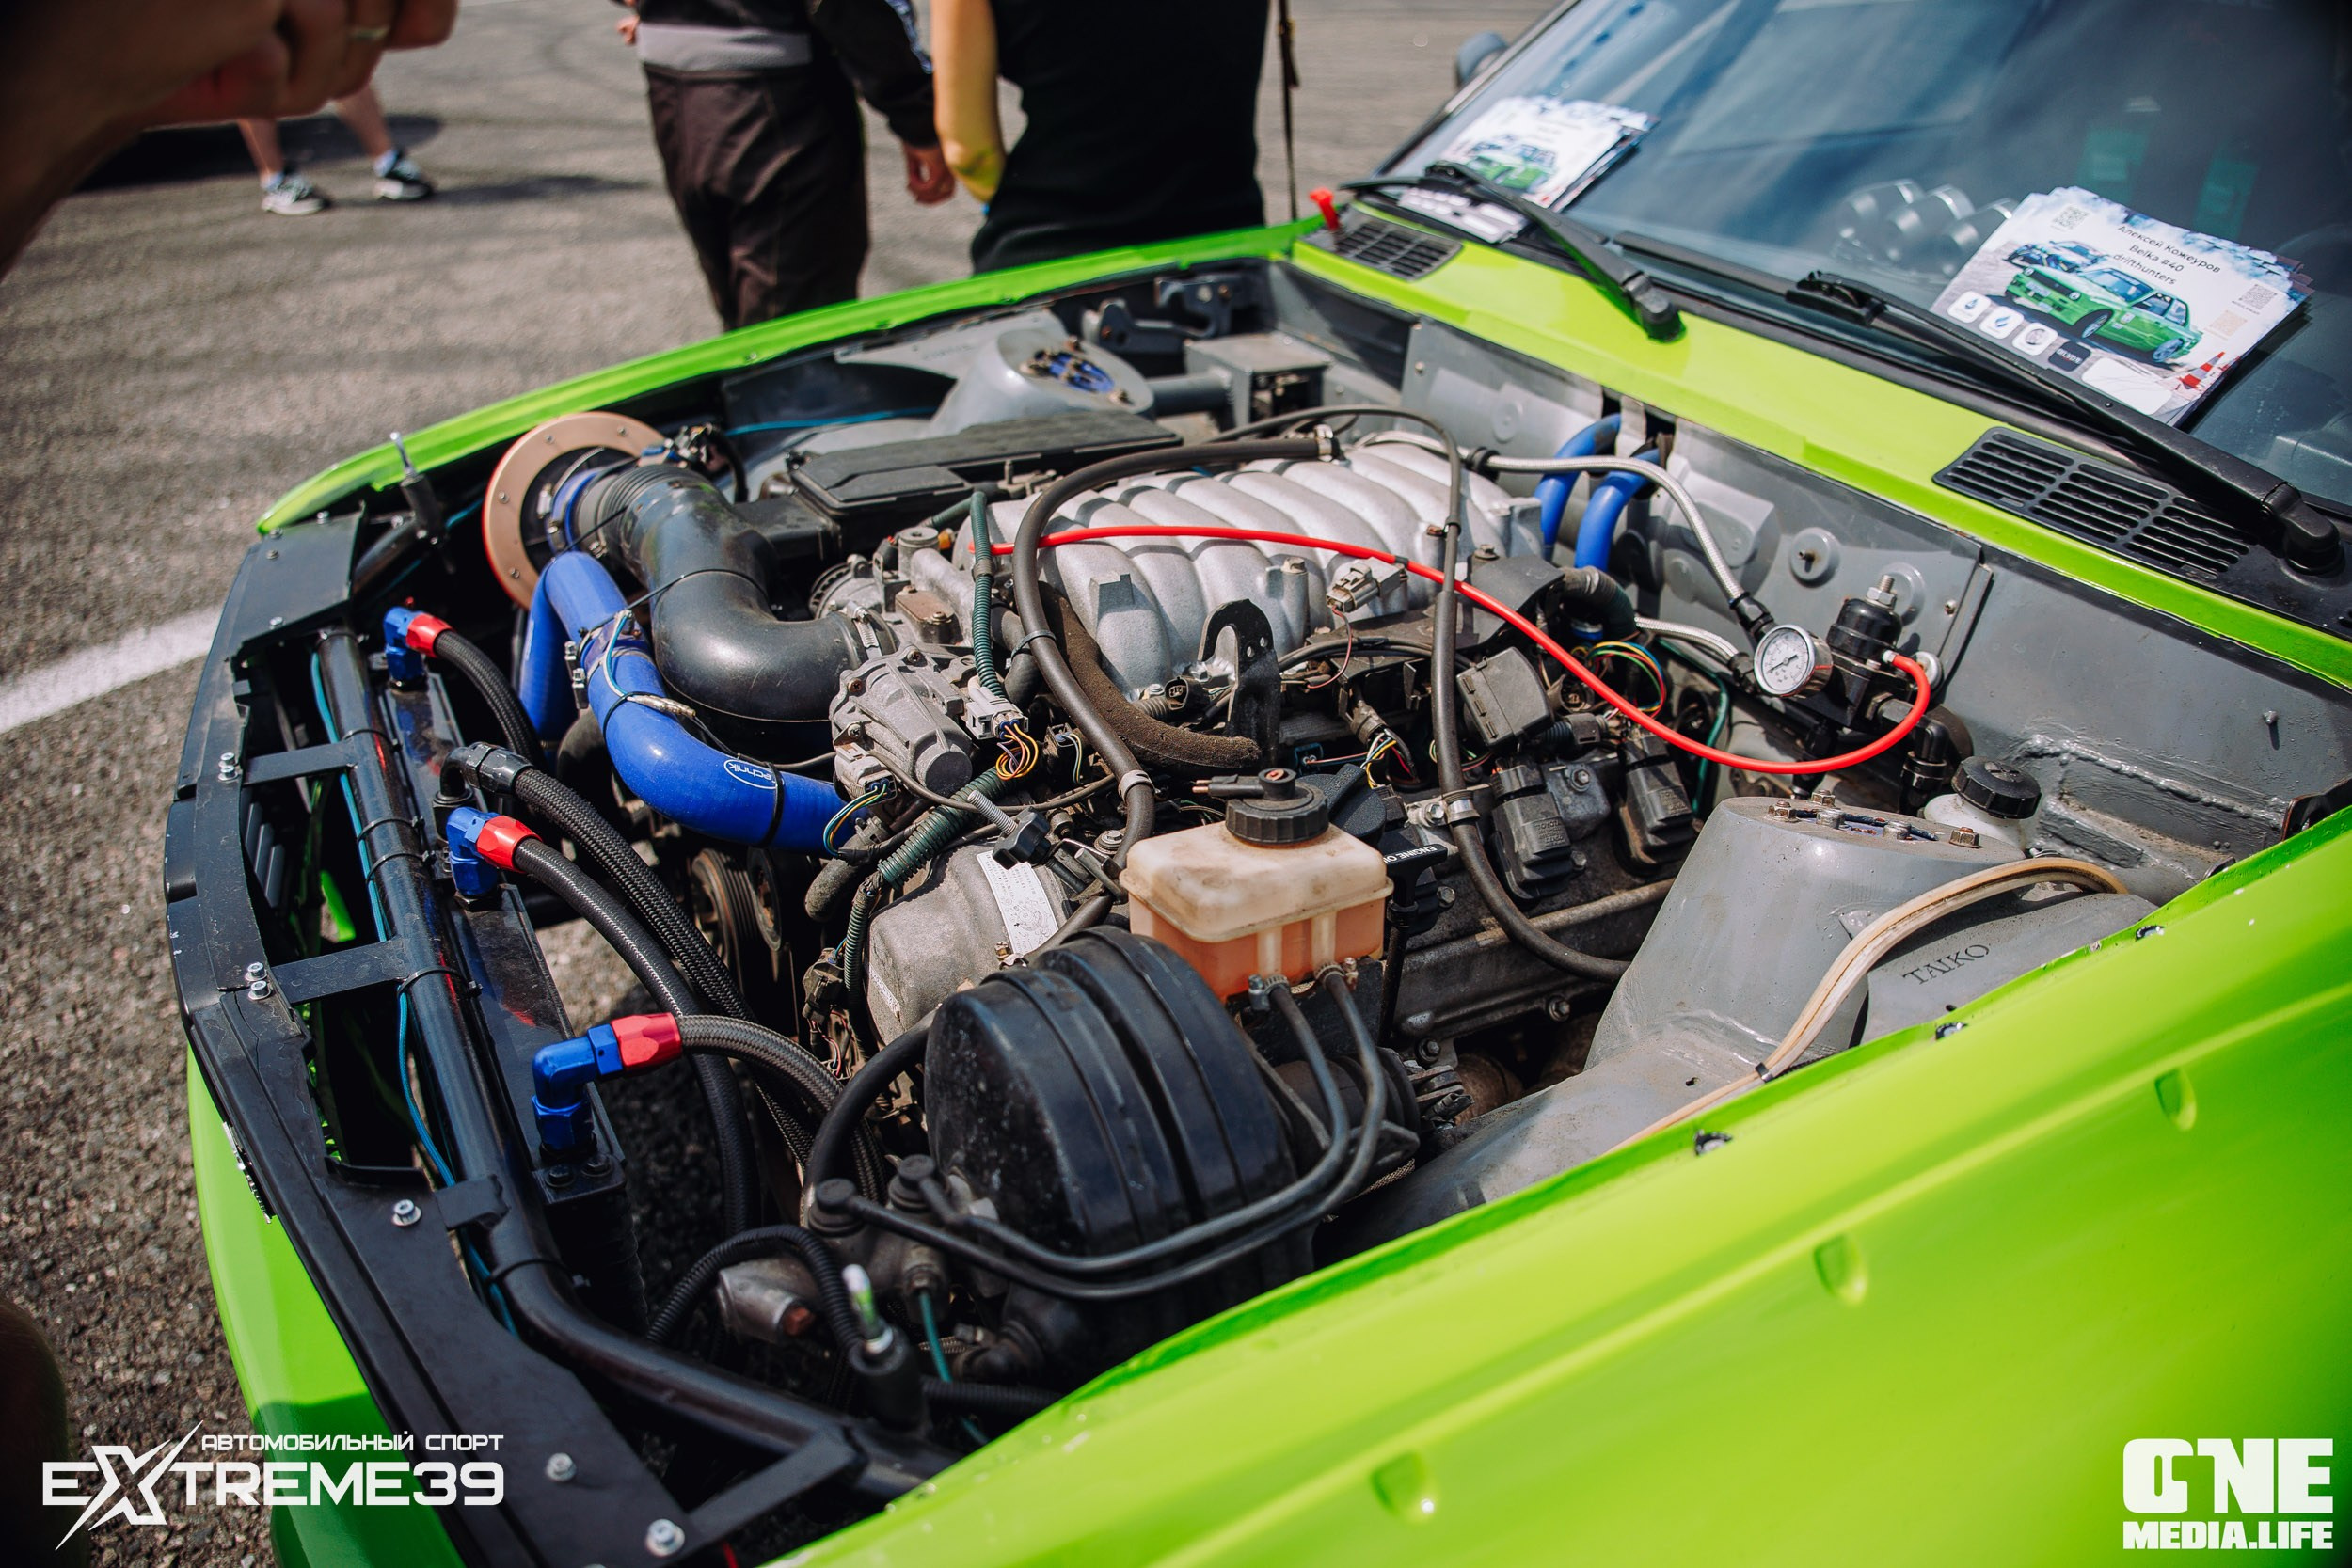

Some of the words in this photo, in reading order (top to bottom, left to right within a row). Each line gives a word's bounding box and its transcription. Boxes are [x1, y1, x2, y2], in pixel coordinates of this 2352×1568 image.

[2117, 226, 2162, 248] Алексей
[2165, 245, 2220, 274] Кожеуров
[2129, 245, 2159, 262] Belka
[2161, 260, 2185, 273] #40
[2113, 253, 2177, 285] drifthunters
[1398, 846, 1438, 859] ENGINE
[1902, 944, 1990, 985] TAIKO
